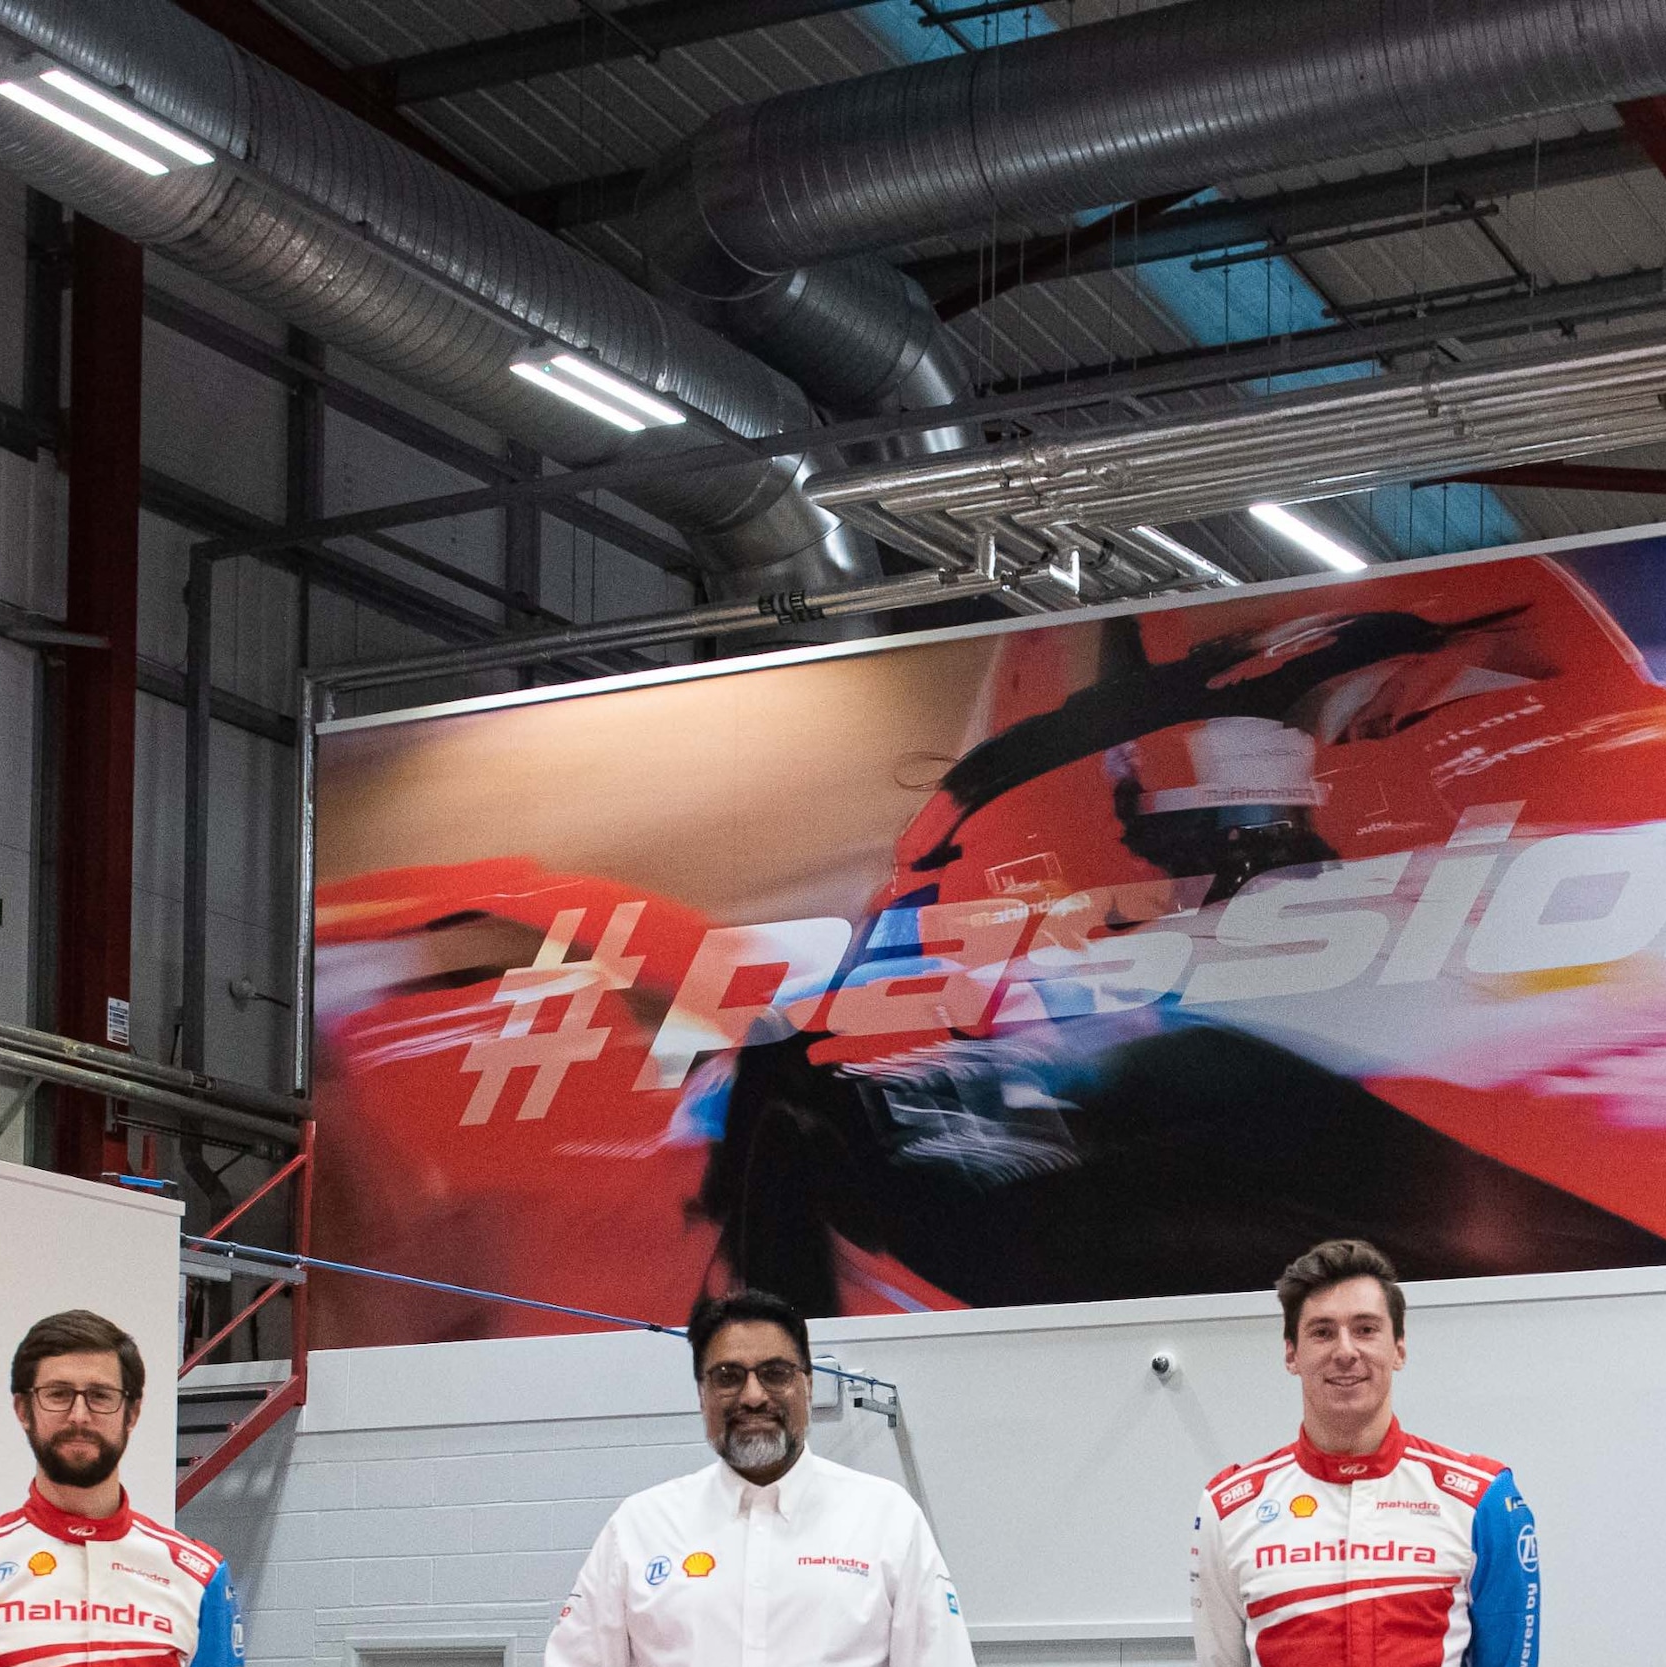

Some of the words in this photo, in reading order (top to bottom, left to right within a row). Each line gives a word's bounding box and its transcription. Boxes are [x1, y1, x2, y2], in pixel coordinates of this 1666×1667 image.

[1221, 1481, 1252, 1506] OMP
[1443, 1472, 1478, 1492] OMP
[179, 1551, 210, 1577] OMP
[645, 1558, 670, 1584] ZF
